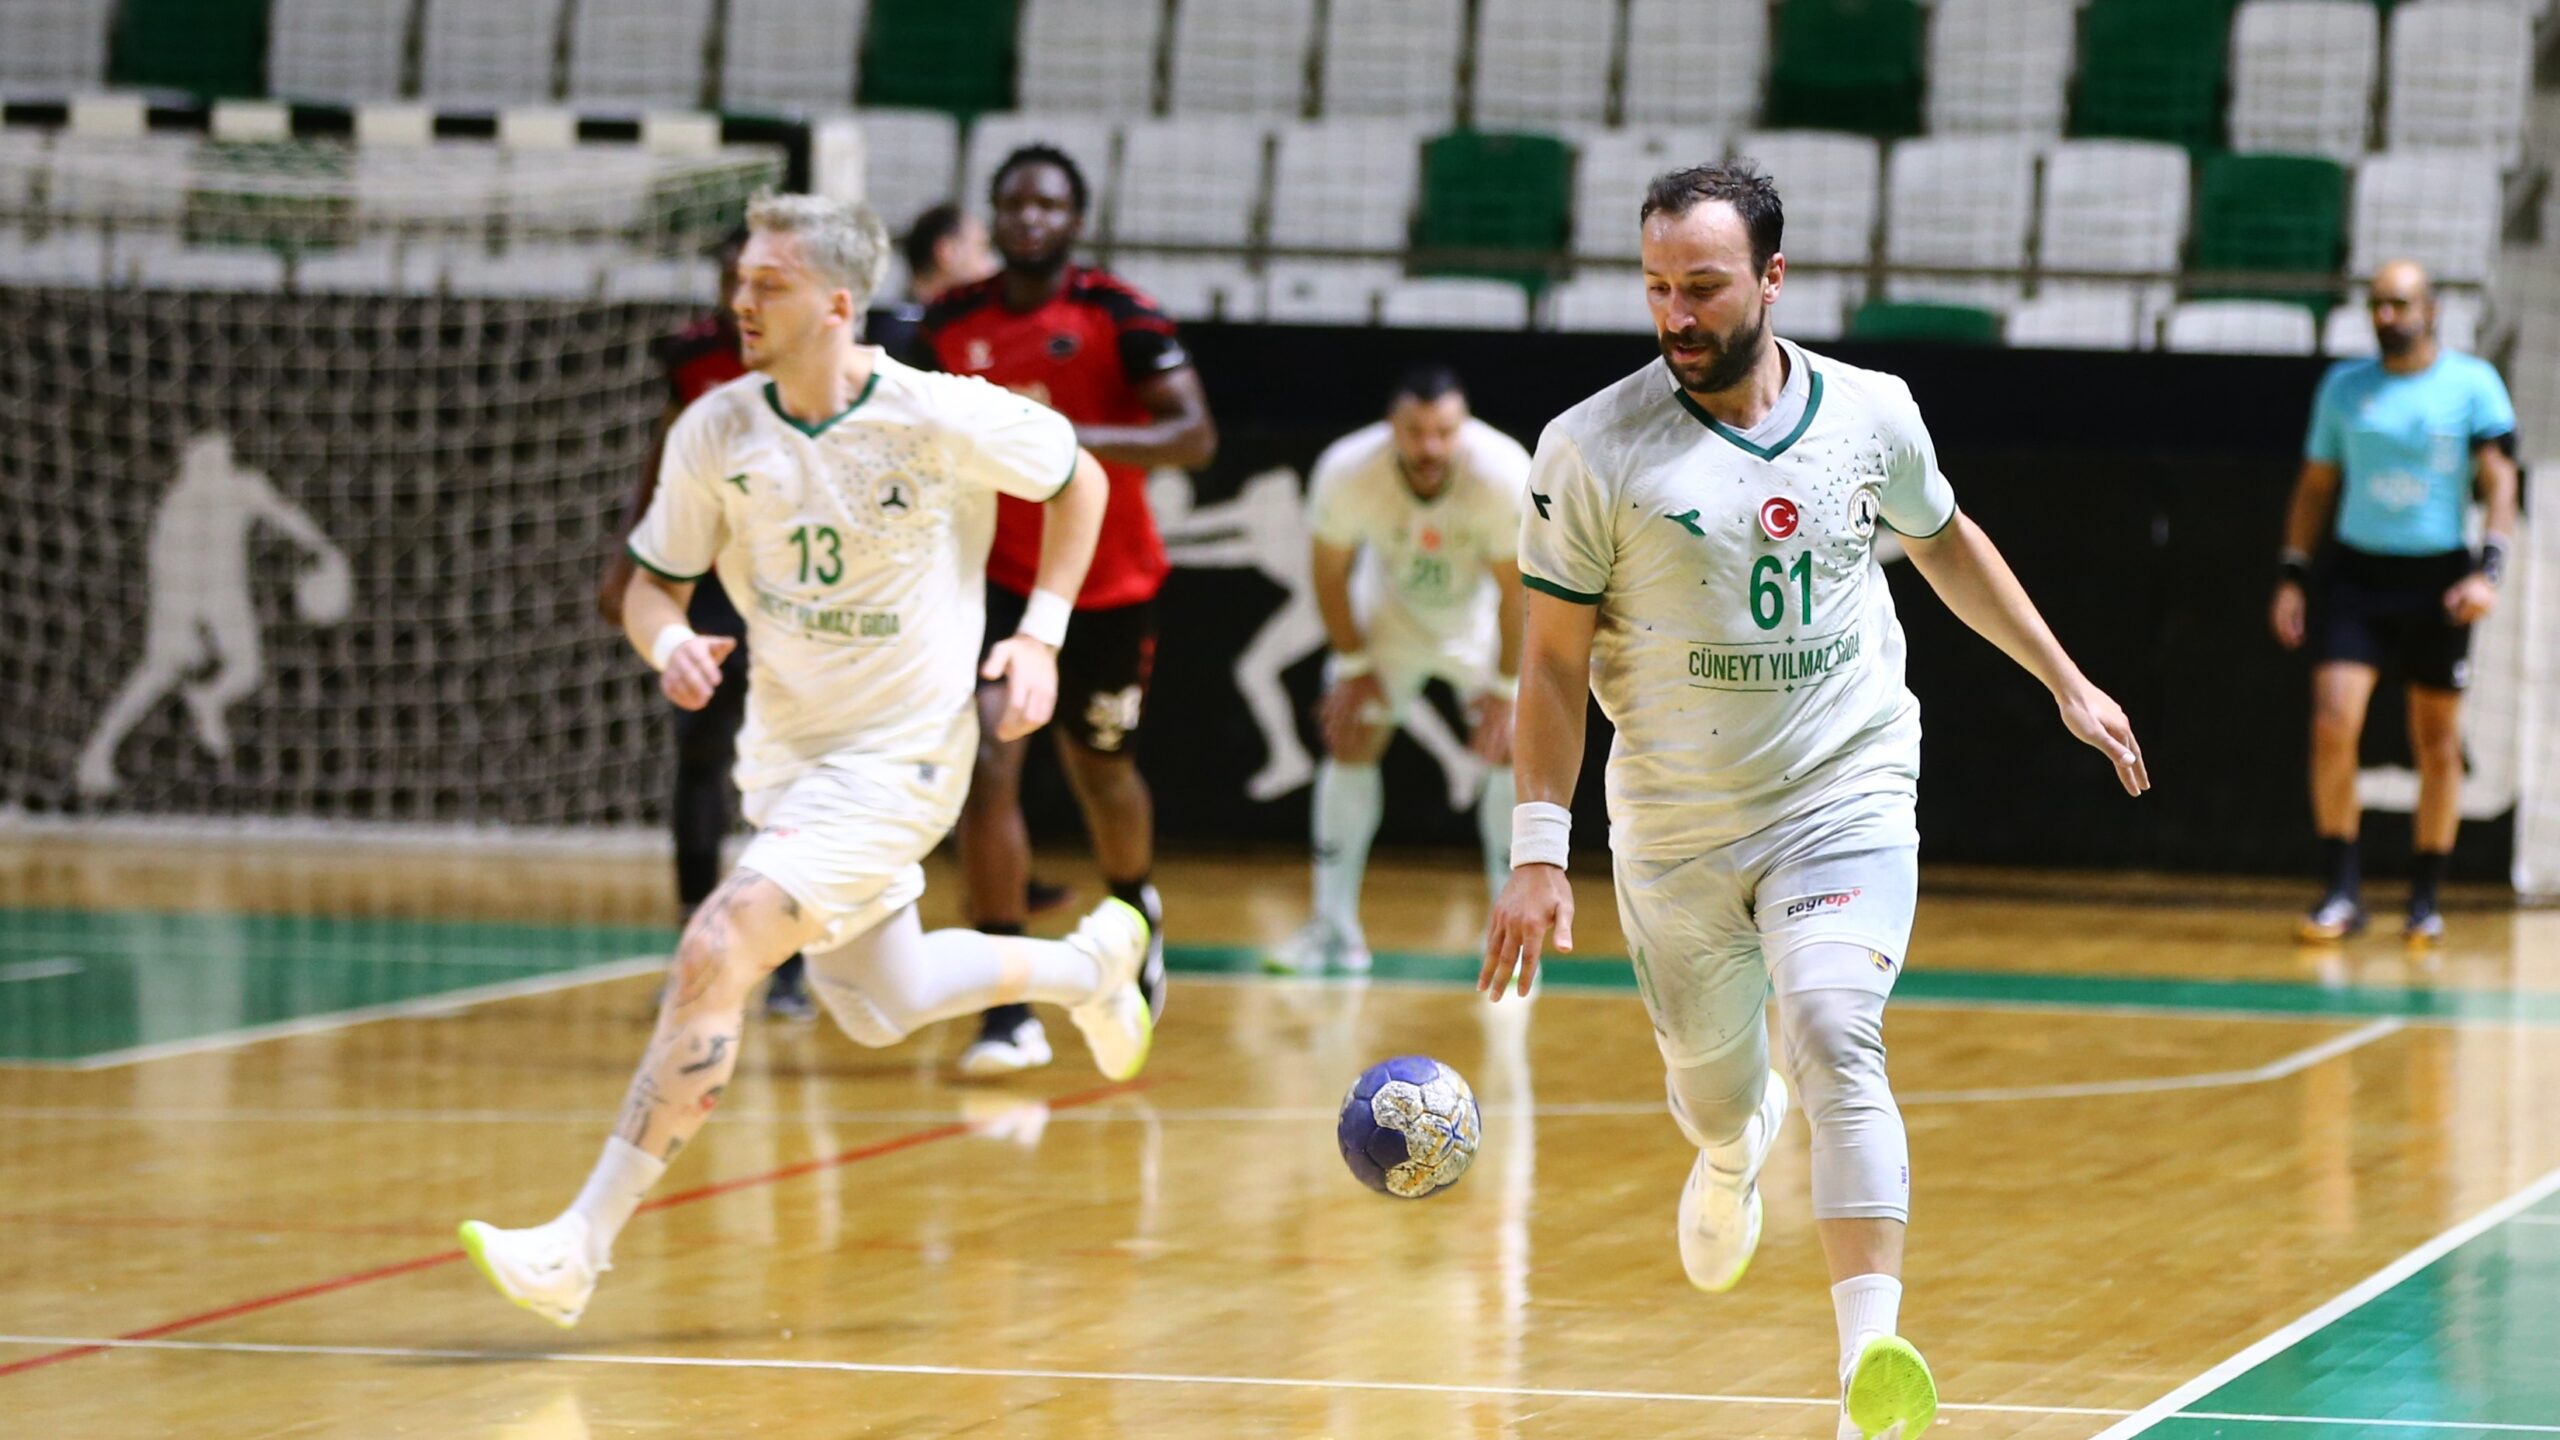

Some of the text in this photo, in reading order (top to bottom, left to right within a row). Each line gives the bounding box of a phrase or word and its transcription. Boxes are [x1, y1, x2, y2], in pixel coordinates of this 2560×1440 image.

[788, 525, 843, 586] 13
[1749, 550, 1812, 630] 61
[1689, 648, 1763, 681] CÜNEYT
[1769, 646, 1833, 681] YILMAZ
